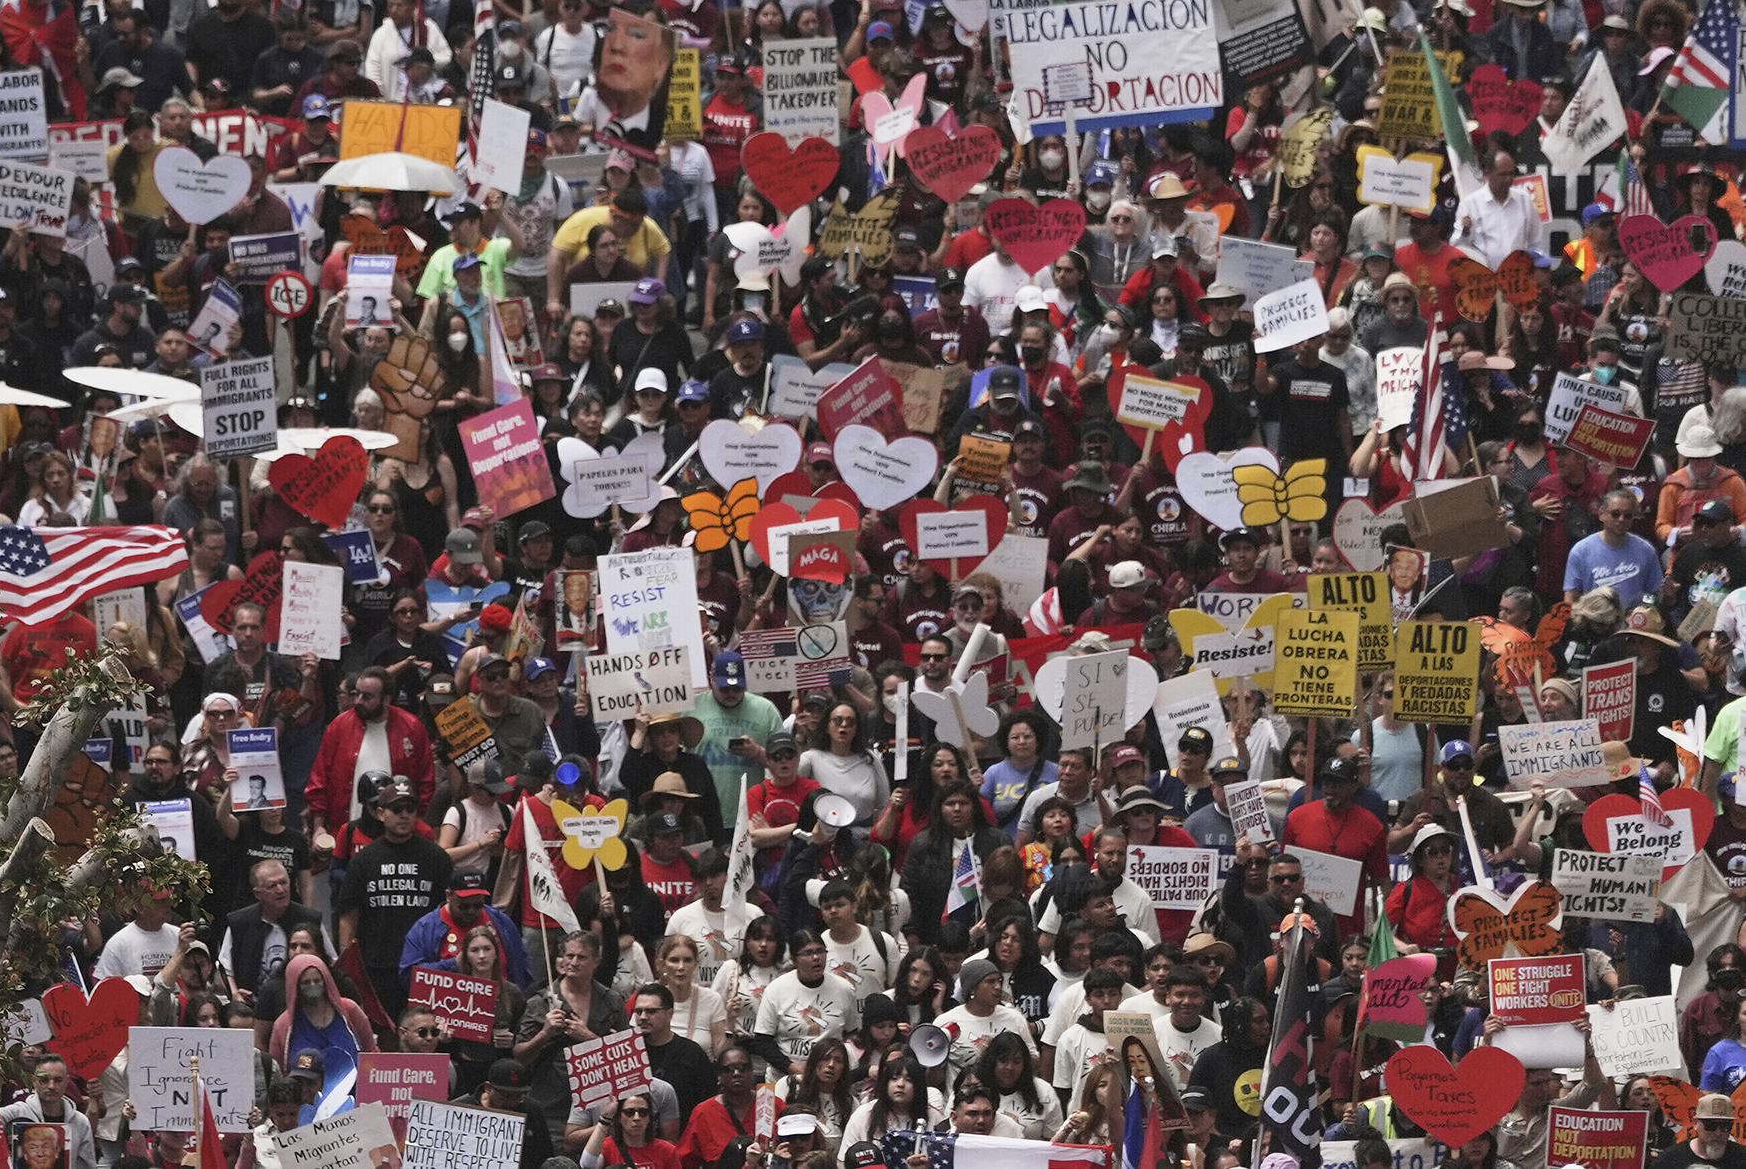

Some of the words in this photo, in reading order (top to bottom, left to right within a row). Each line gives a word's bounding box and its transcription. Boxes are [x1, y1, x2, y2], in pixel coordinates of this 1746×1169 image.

[766, 48, 808, 68] STOP
[812, 46, 838, 64] THE
[1083, 40, 1129, 73] NO
[766, 70, 839, 90] BILLIONAIRE
[766, 91, 838, 109] TAKEOVER
[273, 287, 305, 306] ICE
[1260, 291, 1308, 321] PROTECT
[1261, 304, 1318, 332] FAMILIES
[204, 368, 227, 382] FULL
[231, 361, 269, 377] RIGHTS
[216, 380, 236, 393] FOR
[240, 377, 258, 389] ALL
[1125, 387, 1139, 397] NO
[1141, 389, 1166, 400] MORE
[1587, 385, 1624, 403] CAUSA
[204, 388, 272, 410] IMMIGRANTS
[216, 410, 265, 435] STOP
[1579, 421, 1596, 435] NOT
[1585, 409, 1638, 435] EDUCATION
[471, 423, 497, 445] Fund
[493, 434, 512, 451] not
[1574, 431, 1637, 459] DEPORTATION
[1151, 521, 1188, 534] CHIRLA
[799, 548, 839, 567] MAGA
[1592, 565, 1616, 581] We
[610, 587, 666, 611] RESIST
[1322, 575, 1377, 606] ALTO
[642, 611, 669, 630] ARE
[1307, 611, 1329, 625] LA
[285, 629, 315, 642] Fascist
[1288, 627, 1346, 644] LUCHA
[1411, 625, 1468, 655] ALTO
[1196, 639, 1275, 665] Resiste!
[1282, 645, 1349, 661] OBRERA
[590, 654, 643, 676] HANDS
[1300, 665, 1329, 680] NO
[1421, 657, 1432, 671] A
[1434, 657, 1454, 671] LAS
[1079, 664, 1103, 688] SI
[1399, 675, 1474, 689] DEPORTACIONES
[1292, 681, 1335, 695] TIENE
[1399, 685, 1408, 701] Y
[1410, 685, 1471, 701] REDADAS
[1587, 679, 1634, 694] PROTECT
[598, 686, 688, 712] EDUCATION
[1072, 692, 1096, 713] SE
[1273, 692, 1352, 706] FRONTERAS
[1401, 699, 1466, 715] RACISTAS
[1587, 692, 1632, 709] TRANS
[231, 733, 252, 743] Free
[254, 730, 273, 743] Andry
[480, 738, 495, 750] GO
[1506, 740, 1531, 753] WE
[1535, 739, 1565, 752] ARE
[1570, 735, 1601, 750] ALL
[1507, 750, 1604, 777] IMMIGRANTS
[1615, 822, 1644, 835] We
[1616, 830, 1682, 851] Belong
[381, 863, 395, 876] NO
[397, 863, 419, 876] ONE
[1129, 861, 1188, 875] BORDERS
[1191, 861, 1209, 873] NO
[1558, 851, 1628, 872] PROTECT
[380, 879, 416, 893] ILLEGAL
[1164, 876, 1209, 888] RIGHTS
[1590, 878, 1646, 894] HUMAN
[369, 895, 402, 908] STOLEN
[404, 895, 430, 907] LAND
[1474, 908, 1539, 932] PROTECT
[1472, 924, 1548, 951] FAMILIES
[1494, 967, 1517, 981] ONE
[1517, 964, 1572, 980] STRUGGLE
[416, 971, 454, 989] FUND
[456, 979, 494, 997] CARE
[1370, 976, 1428, 992] mental
[1494, 980, 1517, 996] ONE
[1518, 981, 1550, 994] FIGHT
[1495, 994, 1548, 1010] WORKERS
[1551, 991, 1581, 1007] UNITE
[1620, 1002, 1665, 1028] BUILT
[1617, 1022, 1676, 1050] COUNTRY
[162, 1037, 216, 1069] Fight
[575, 1052, 604, 1072] SOME
[606, 1042, 632, 1061] CUTS
[369, 1067, 400, 1083] Fund
[402, 1069, 437, 1086] Care,
[581, 1067, 611, 1087] DON'T
[613, 1056, 641, 1075] HEAL
[391, 1087, 412, 1102] not
[1427, 1086, 1477, 1104] Taxes
[409, 1104, 434, 1126] ALL
[1555, 1113, 1624, 1131] EDUCATION
[313, 1114, 357, 1135] Manos
[408, 1126, 468, 1152] DESERVE
[476, 1136, 488, 1157] TO
[492, 1139, 522, 1163] LIVE
[1554, 1131, 1580, 1143] NOT
[294, 1133, 360, 1163] Migrantes
[406, 1144, 435, 1166] WITH
[1554, 1142, 1637, 1159] DEPORTATION
